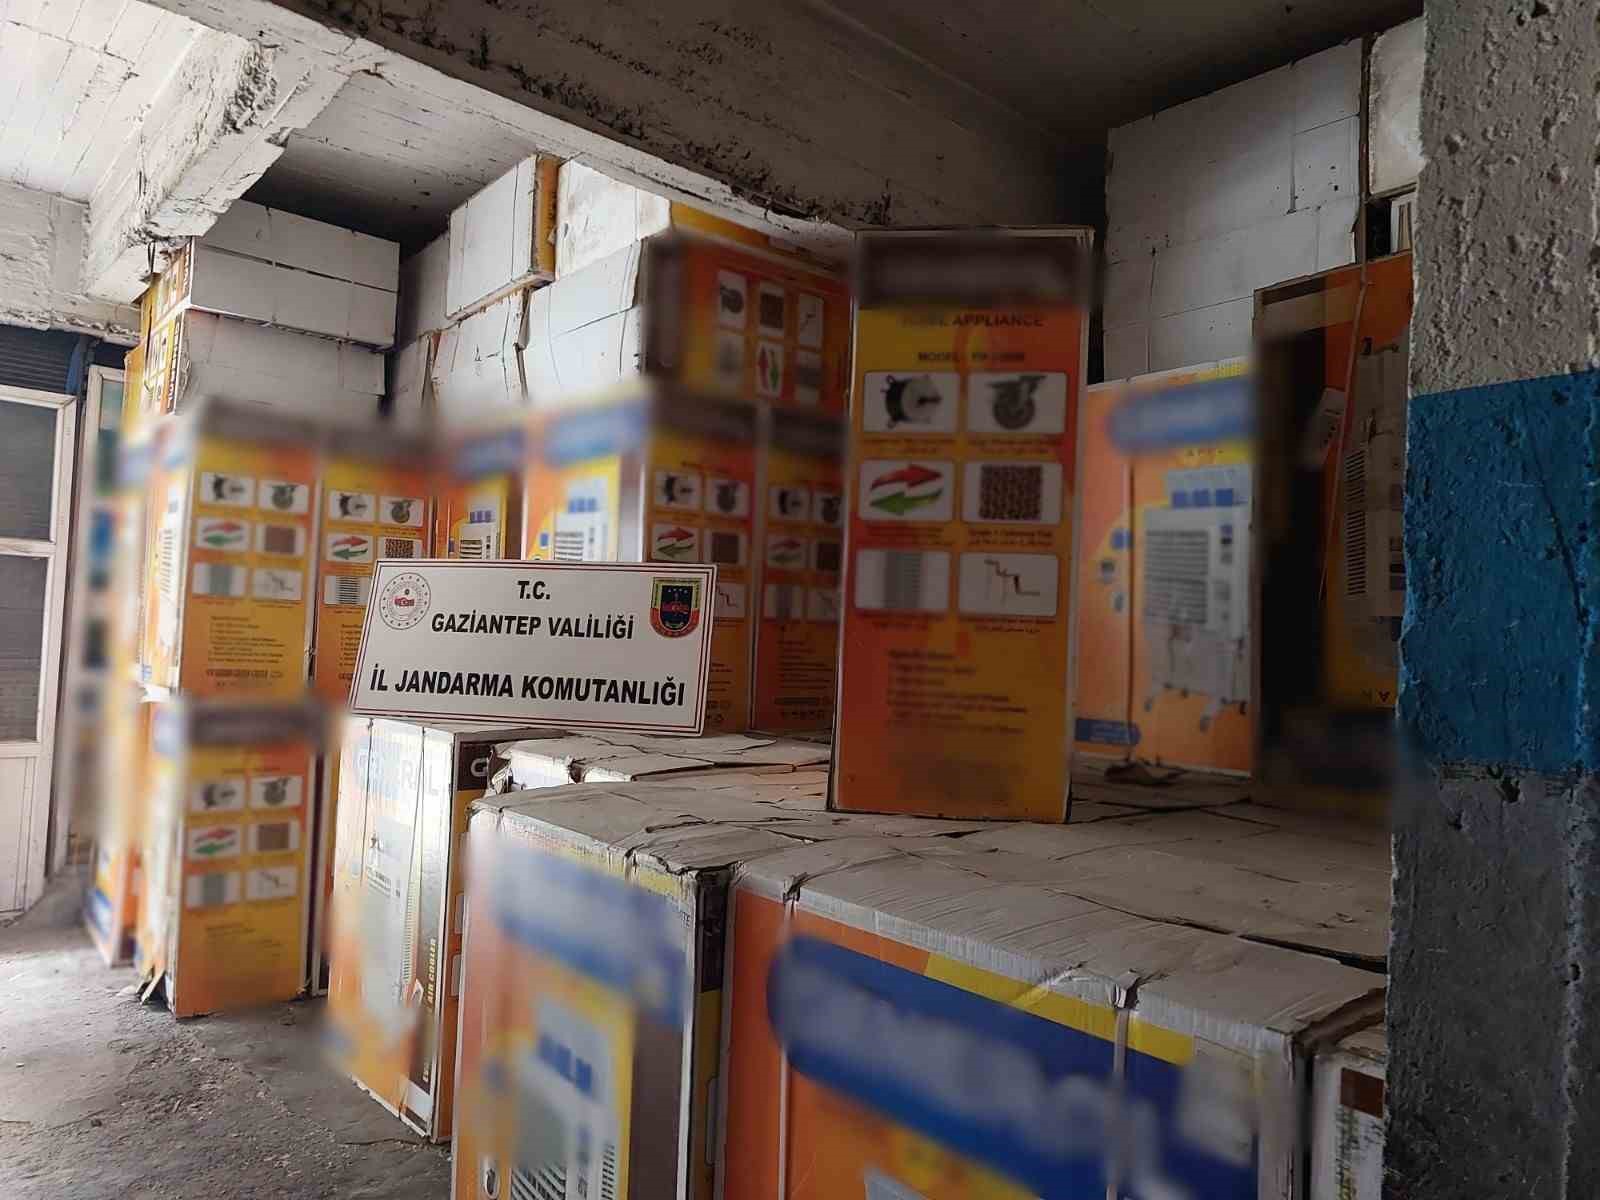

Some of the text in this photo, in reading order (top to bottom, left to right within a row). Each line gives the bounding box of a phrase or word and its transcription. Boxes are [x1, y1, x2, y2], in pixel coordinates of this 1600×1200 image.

[517, 580, 551, 600] T.C.
[431, 610, 634, 640] GAZİANTEP VALİLİĞİ
[369, 663, 388, 691] İL
[394, 670, 514, 698] JANDARMA
[521, 676, 686, 706] KOMUTANLIĞI
